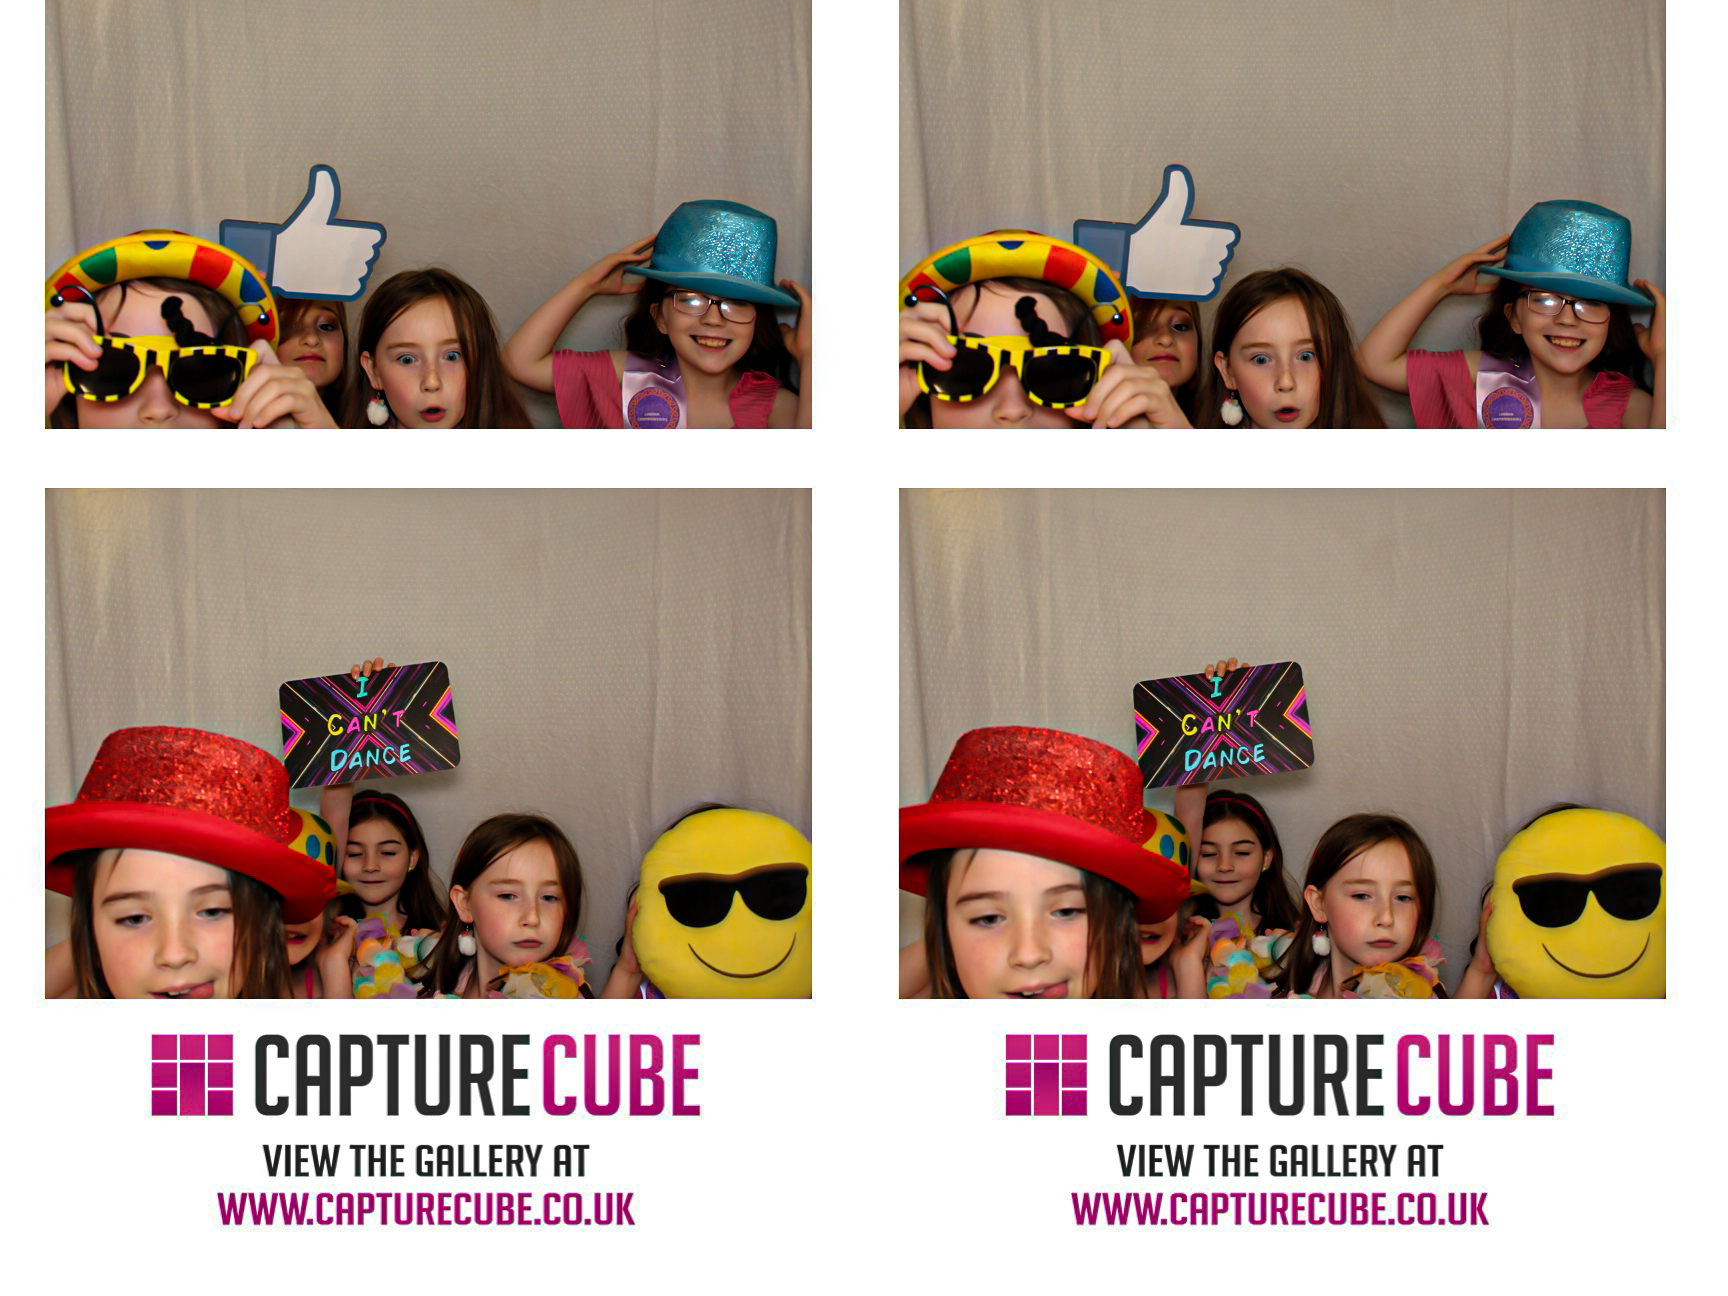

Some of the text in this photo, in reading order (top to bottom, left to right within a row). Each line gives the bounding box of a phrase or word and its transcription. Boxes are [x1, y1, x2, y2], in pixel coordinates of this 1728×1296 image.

[356, 676, 369, 698] I
[1210, 676, 1223, 698] I
[327, 708, 406, 736] CAN'T
[1181, 708, 1260, 736] CAN'T
[330, 743, 412, 772] DANCE
[1184, 743, 1266, 772] DANCE
